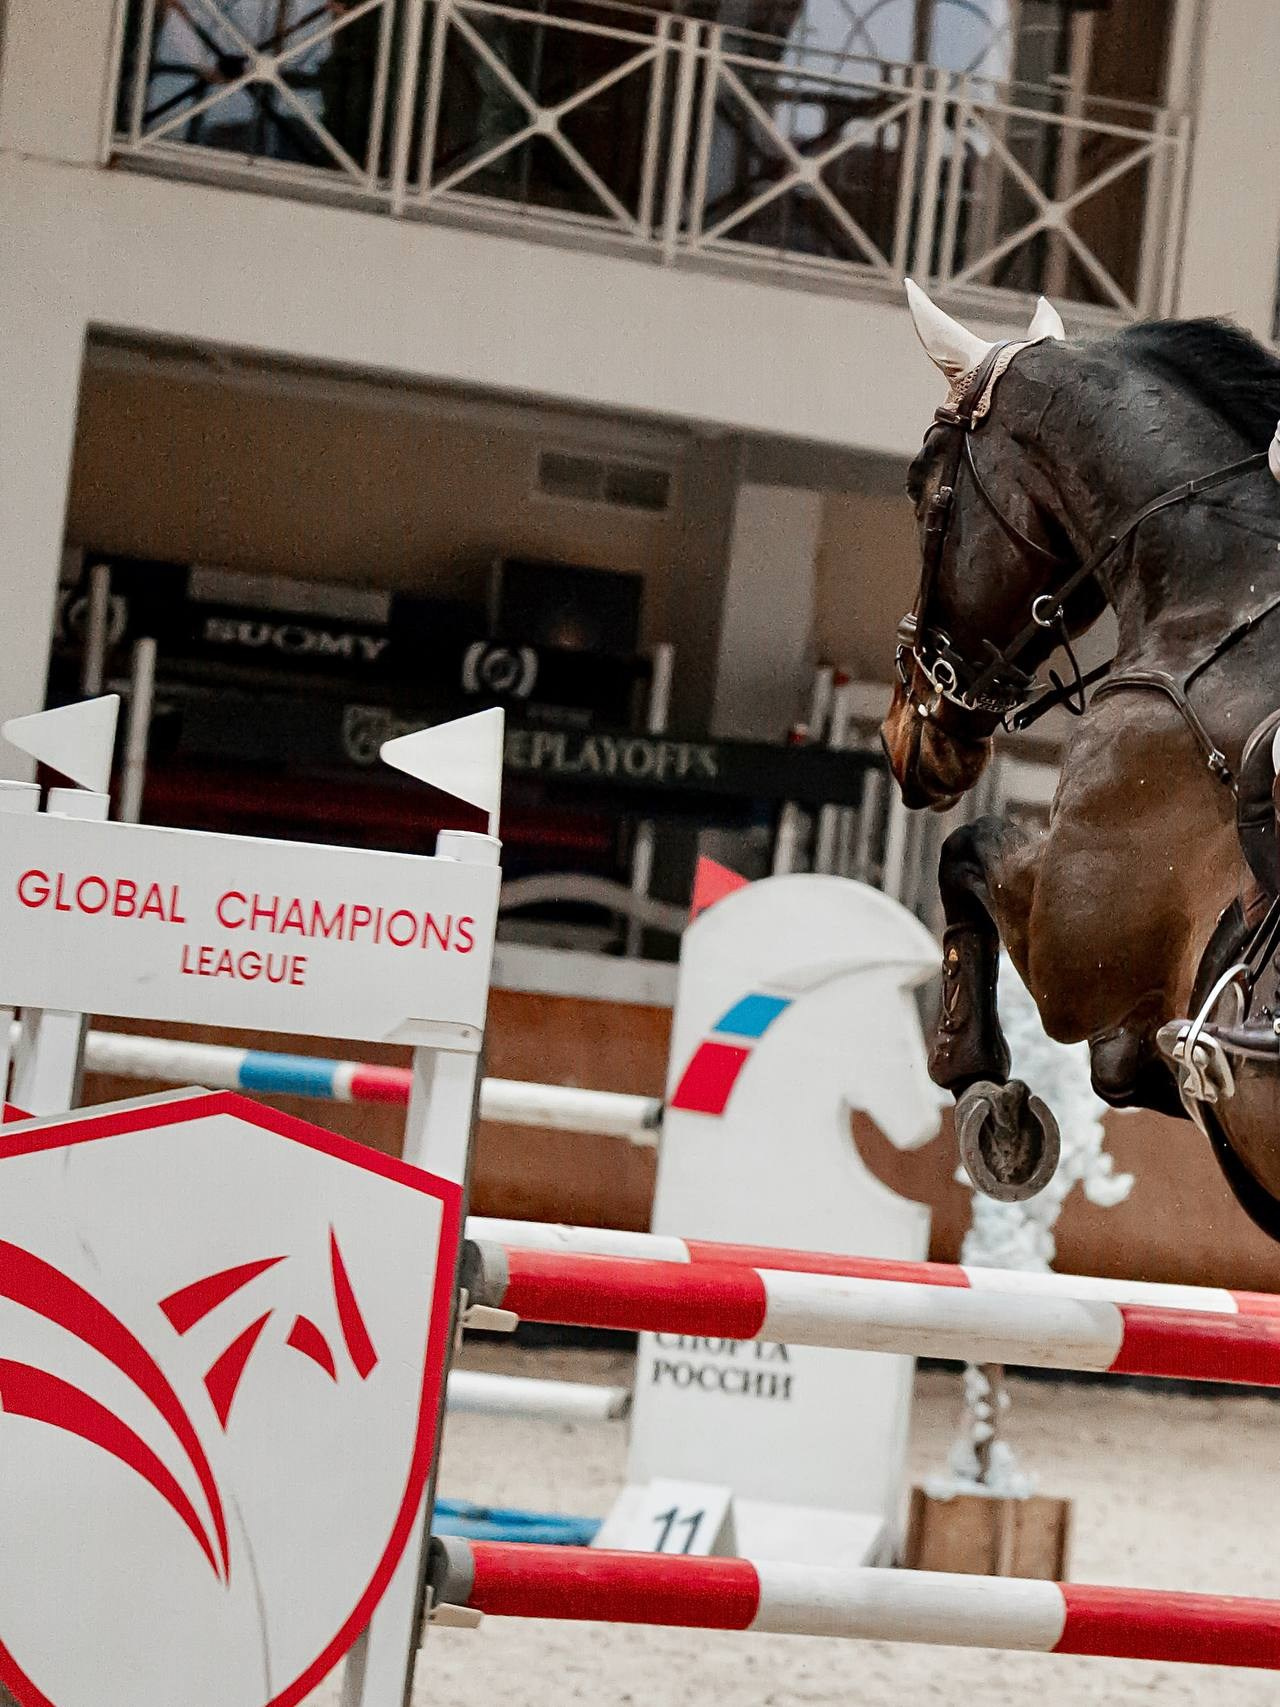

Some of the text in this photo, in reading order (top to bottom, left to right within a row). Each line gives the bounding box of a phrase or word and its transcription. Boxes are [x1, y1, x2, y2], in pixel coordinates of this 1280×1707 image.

[202, 616, 389, 661] SUOMY
[17, 868, 476, 954] GLOBAL CHAMPIONS
[180, 943, 309, 987] LEAGUE
[652, 1359, 792, 1400] РОССИИ
[653, 1506, 705, 1554] 11
